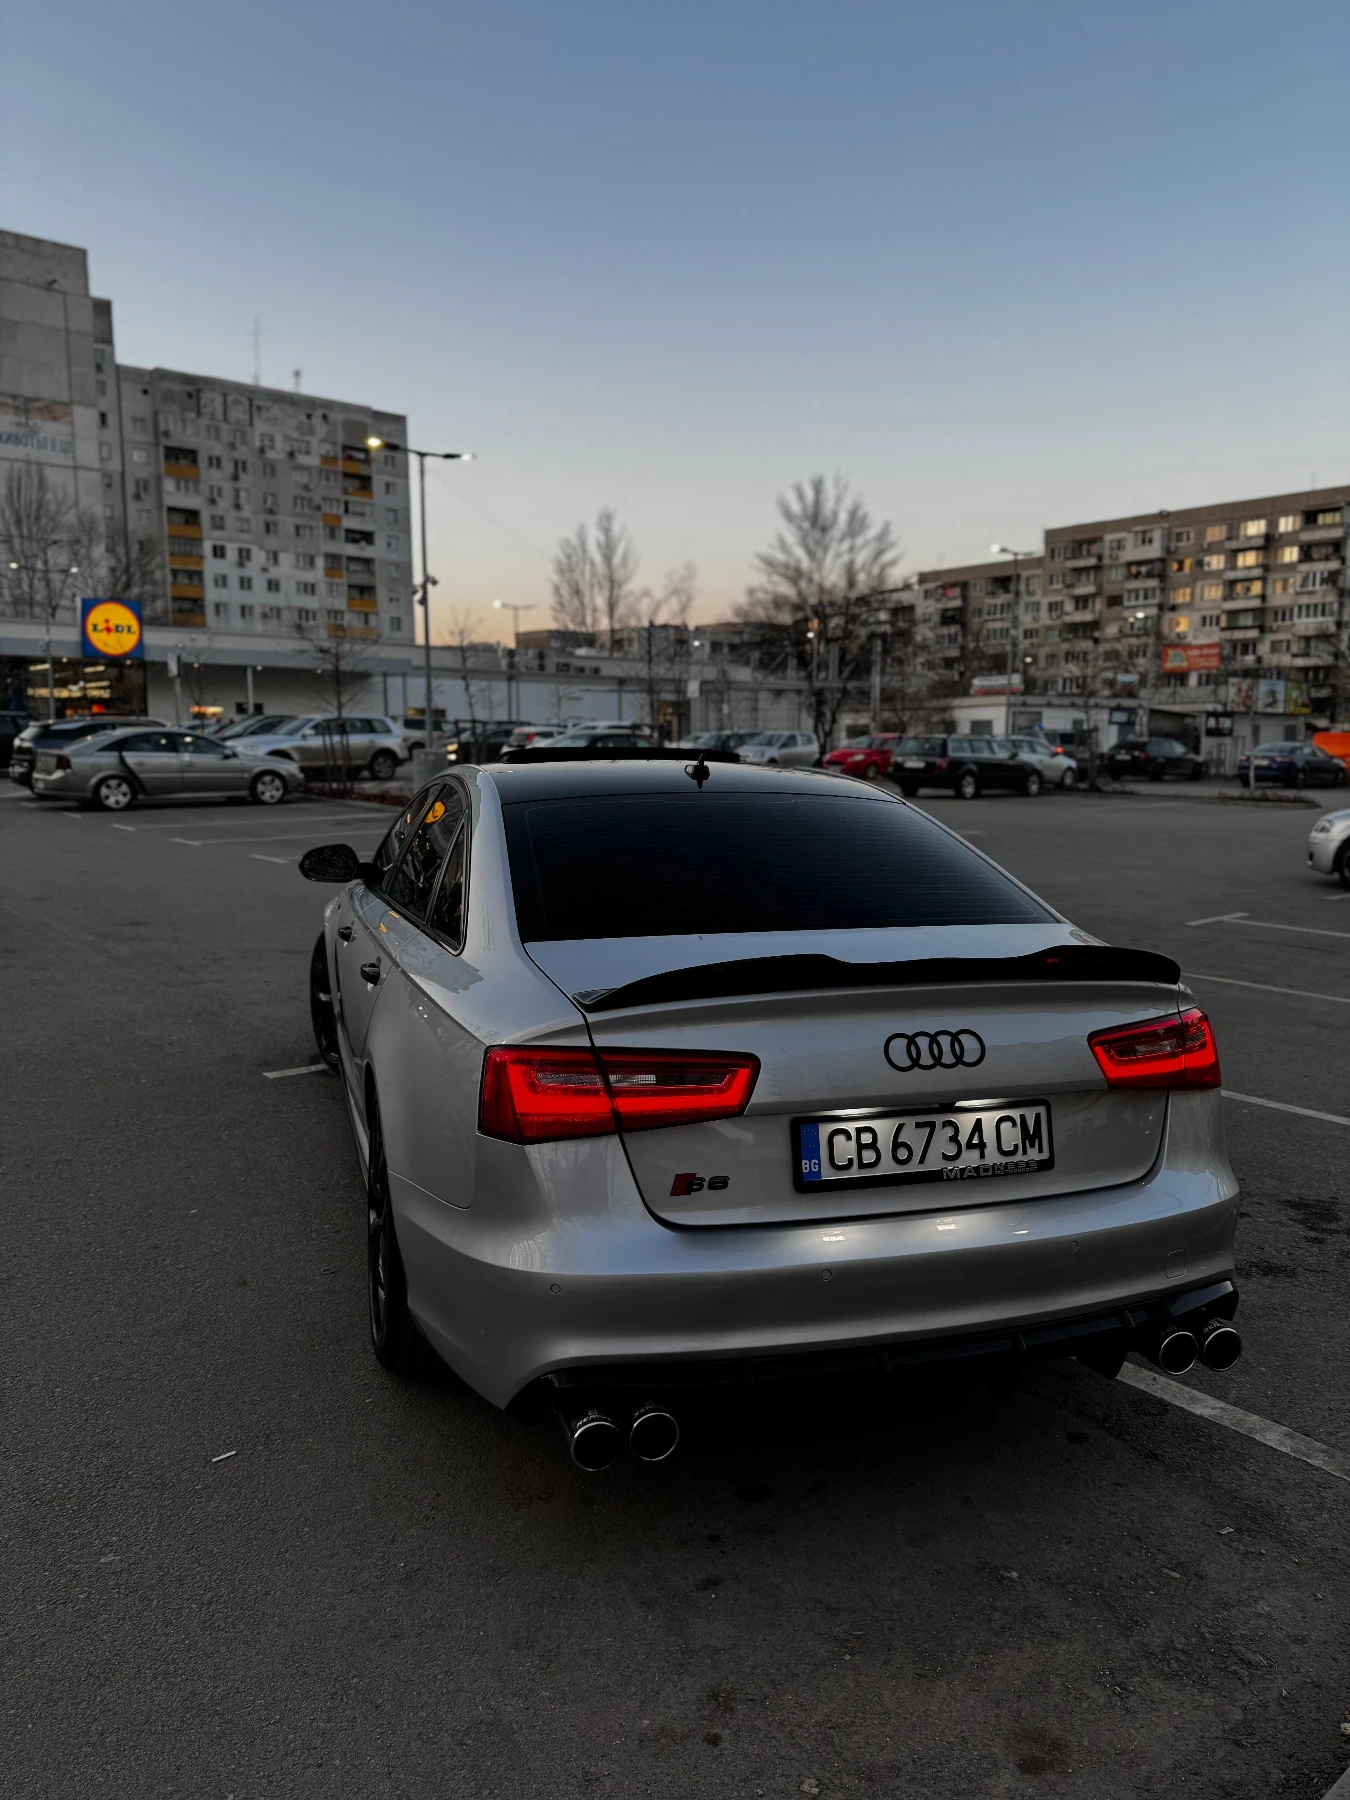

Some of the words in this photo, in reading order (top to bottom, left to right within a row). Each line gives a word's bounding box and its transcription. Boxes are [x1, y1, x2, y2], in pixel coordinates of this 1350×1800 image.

[827, 1126, 881, 1171] CB
[891, 1118, 987, 1165] 6734
[995, 1112, 1044, 1156] CM
[802, 1159, 819, 1173] BG
[942, 1160, 1038, 1180] MADNESS
[994, 1166, 1038, 1175] MOTORSPORT
[684, 1175, 730, 1192] S6
